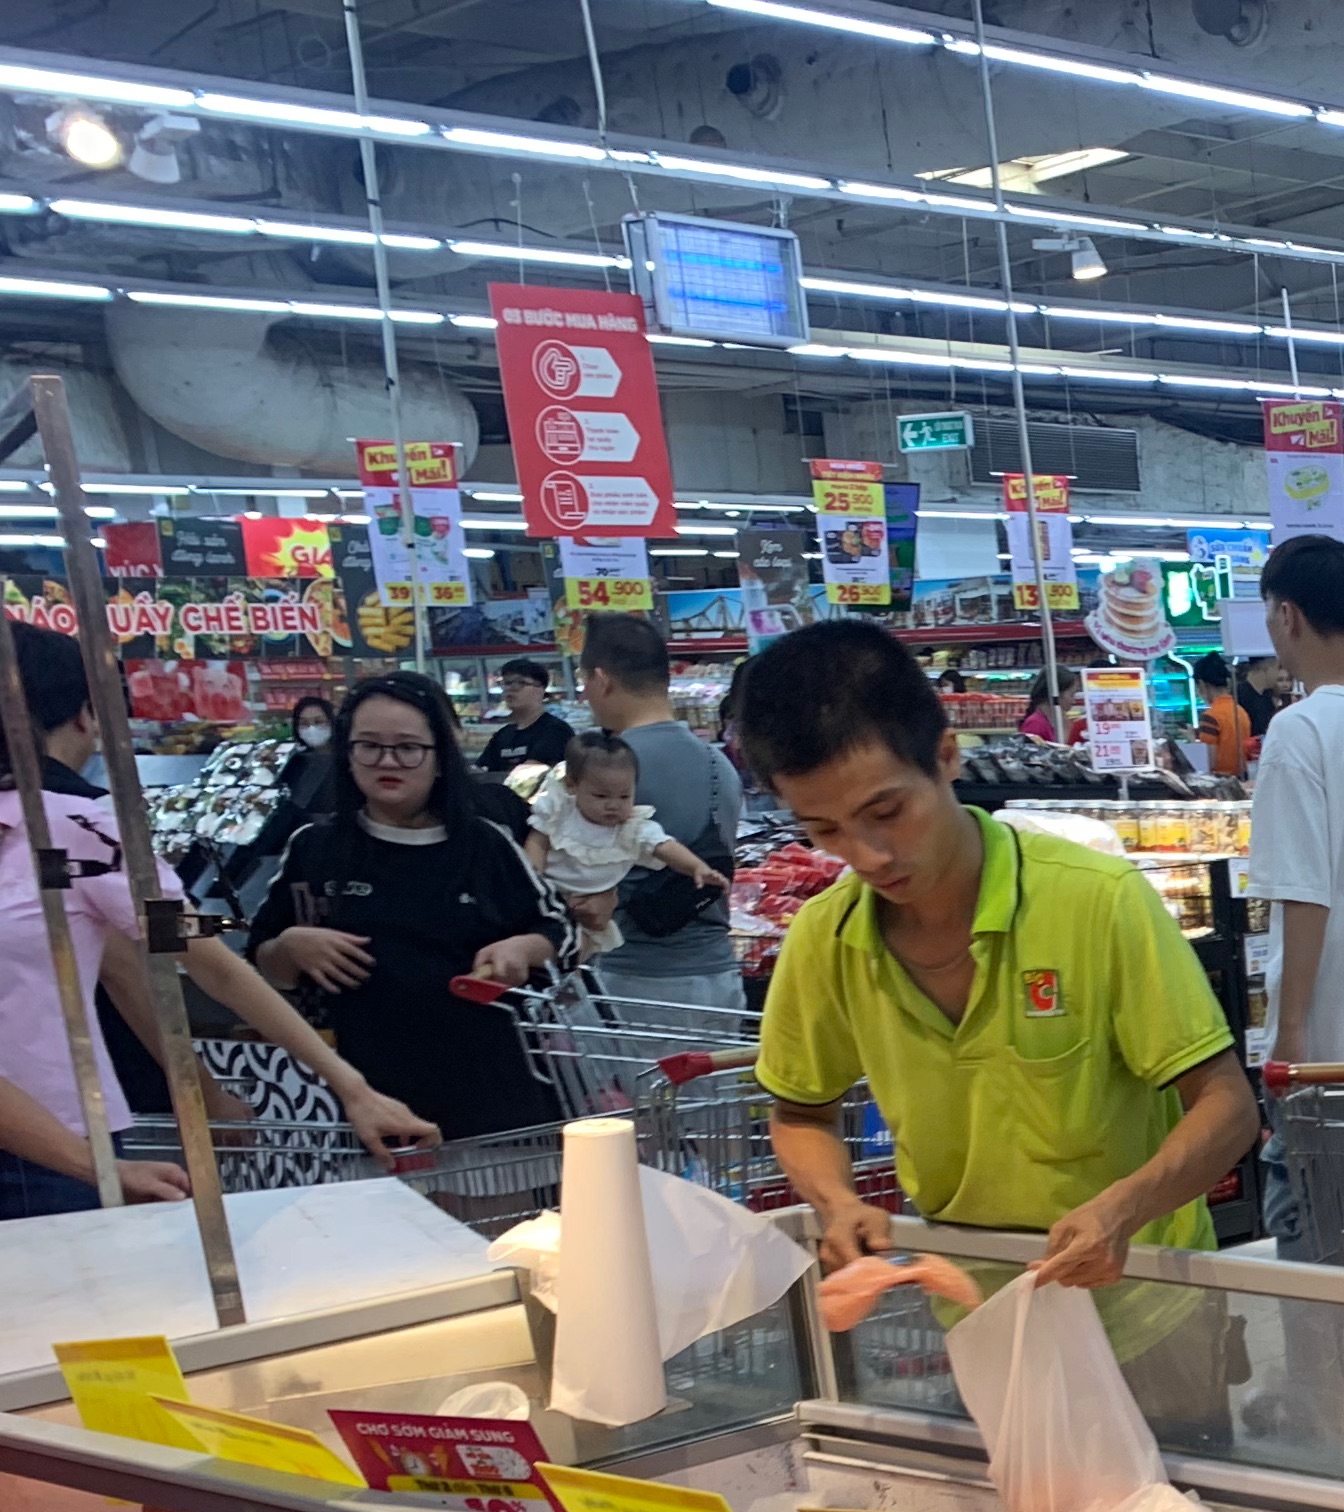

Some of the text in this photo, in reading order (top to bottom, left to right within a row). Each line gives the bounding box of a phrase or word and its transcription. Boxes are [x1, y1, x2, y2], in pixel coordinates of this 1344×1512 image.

[181, 590, 321, 634] CHẾ BIẾN
[356, 1422, 516, 1444] CHỢ SỚM GIẢM SUNG
